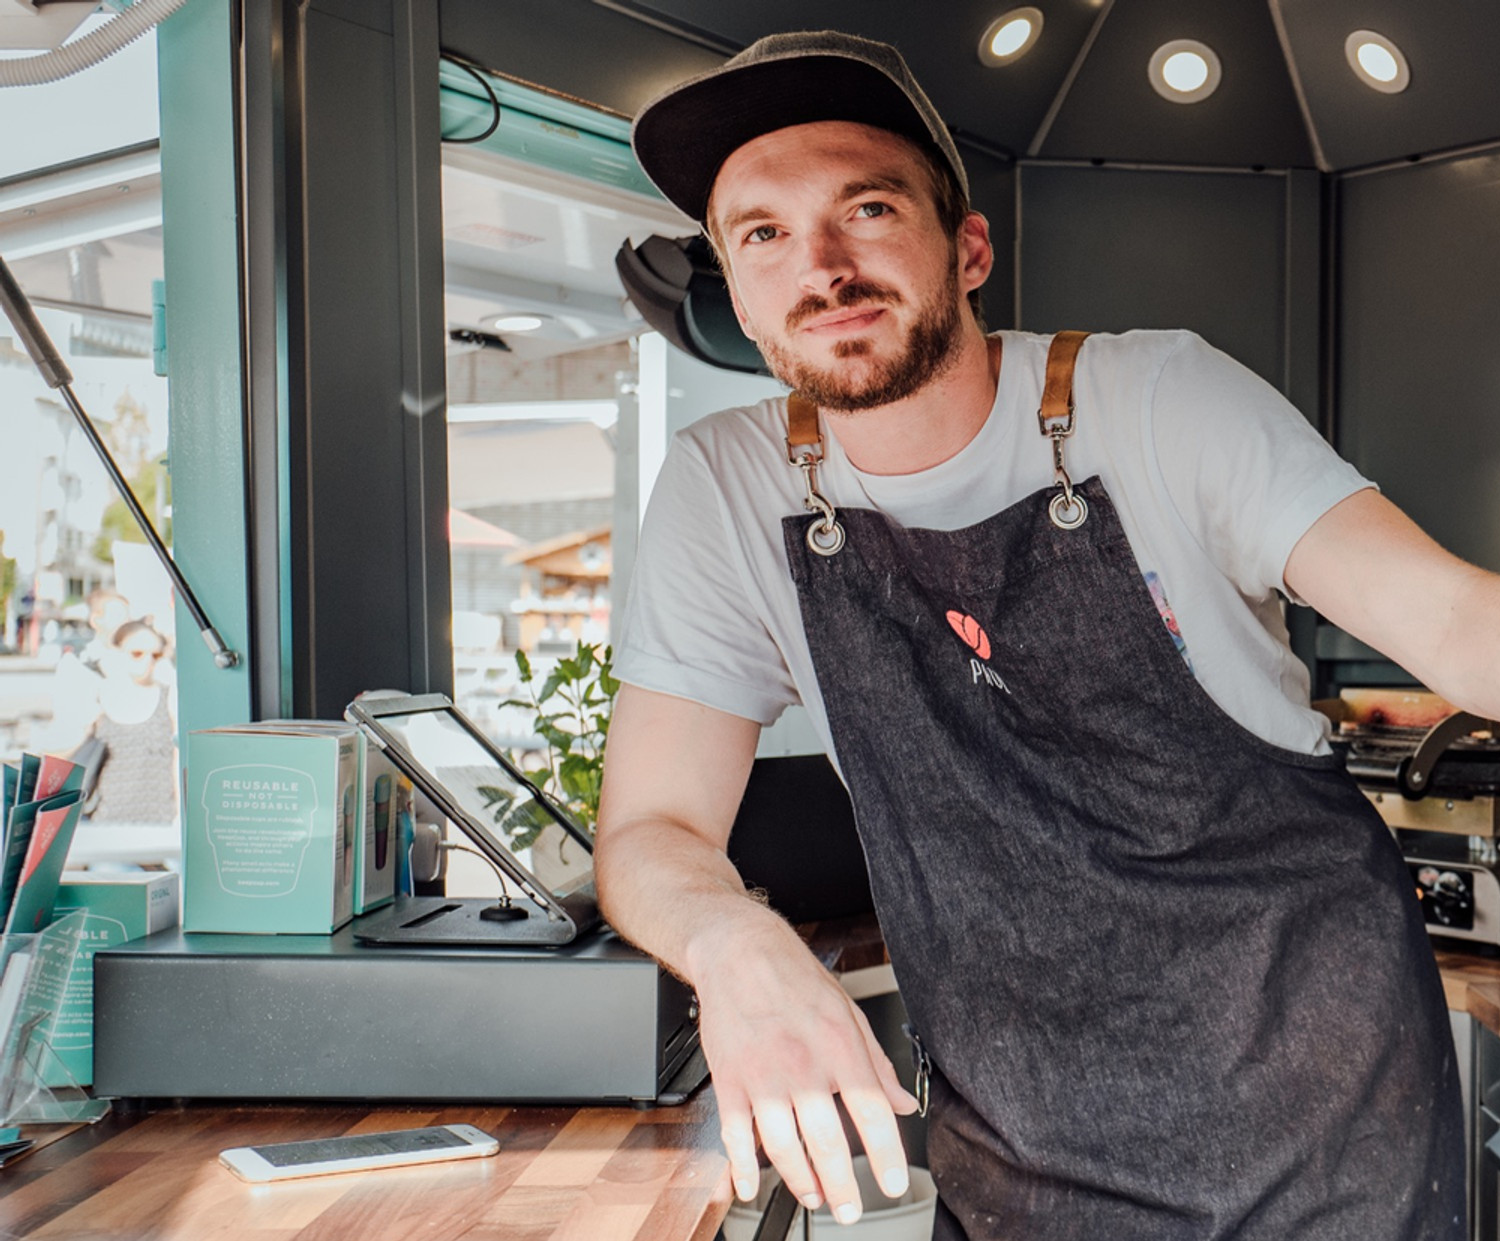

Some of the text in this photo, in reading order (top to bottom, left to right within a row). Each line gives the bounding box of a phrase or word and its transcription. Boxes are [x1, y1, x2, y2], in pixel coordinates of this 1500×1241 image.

[222, 780, 299, 792] REUSABLE
[248, 792, 273, 800] NOT
[222, 800, 299, 811] DISPOSABLE
